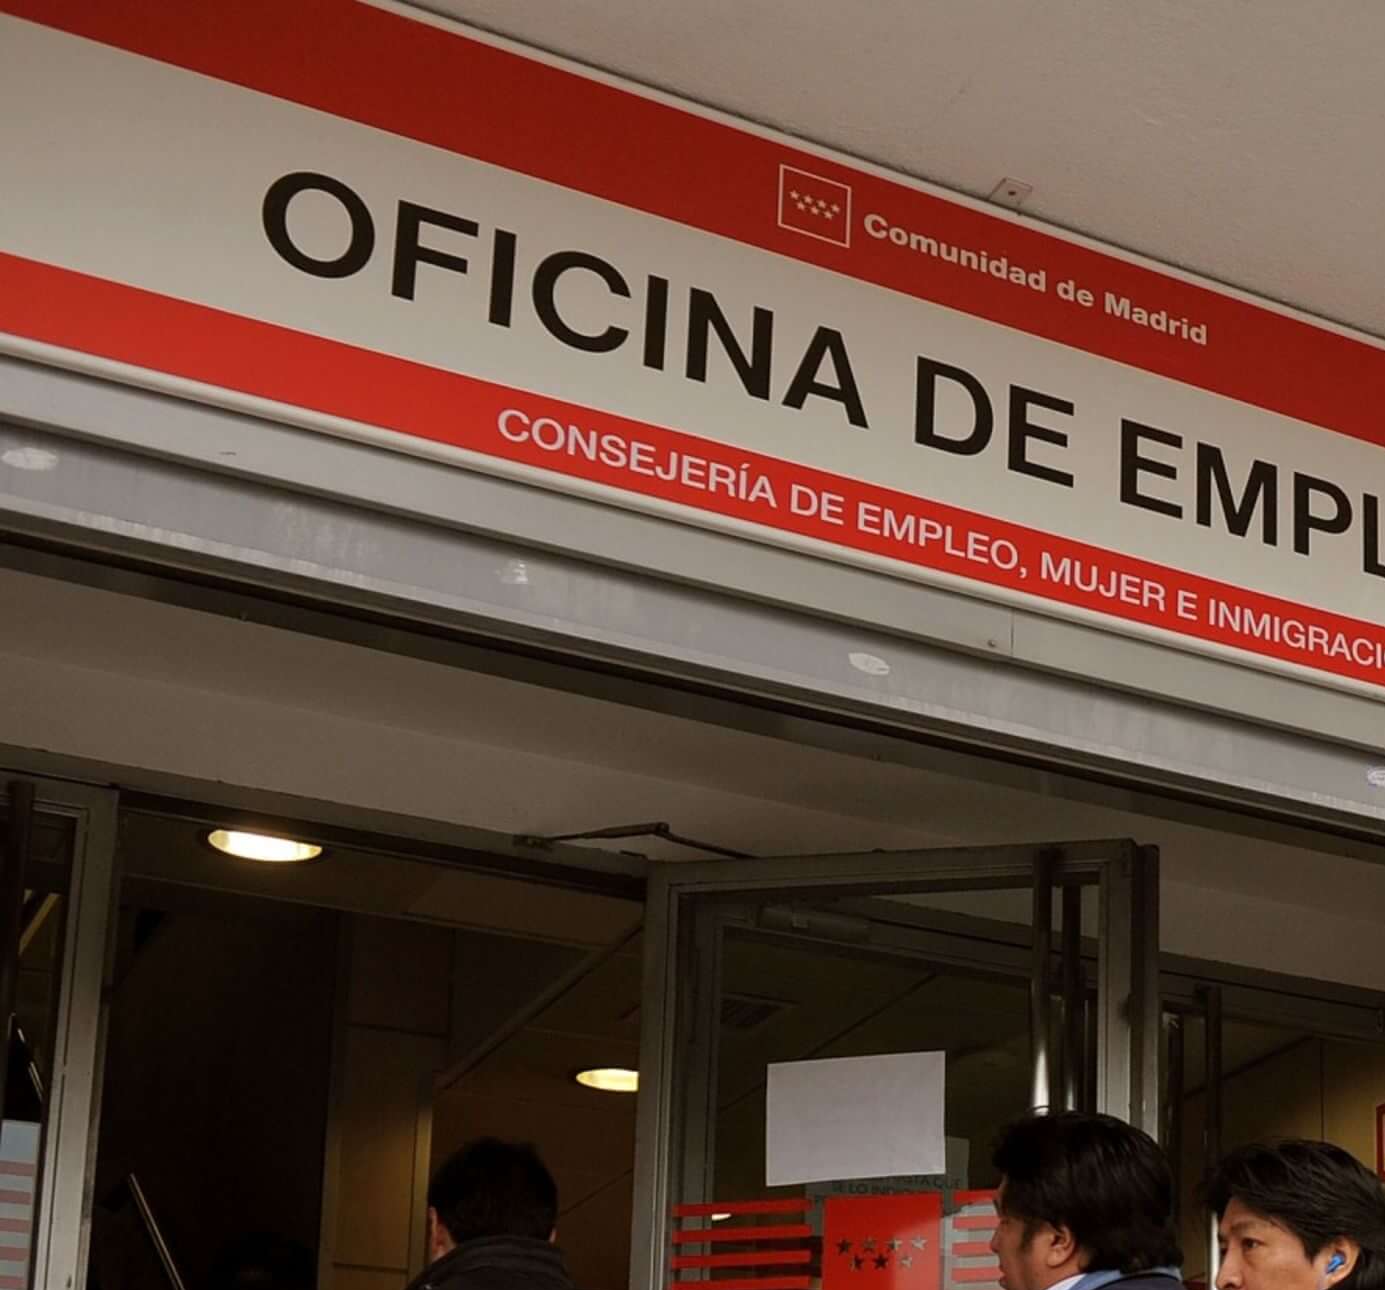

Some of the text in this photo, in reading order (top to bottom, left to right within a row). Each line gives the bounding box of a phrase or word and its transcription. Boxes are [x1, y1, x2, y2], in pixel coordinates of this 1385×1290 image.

[262, 171, 869, 429] OFICINA
[914, 355, 1075, 488] DE
[864, 213, 1208, 345] Comunidad de Madrid
[497, 408, 777, 508] CONSEJERÍA
[790, 483, 845, 525] DE
[857, 501, 1030, 580] EMPLEO,
[1040, 551, 1166, 612] MUJER
[1177, 589, 1198, 621] E
